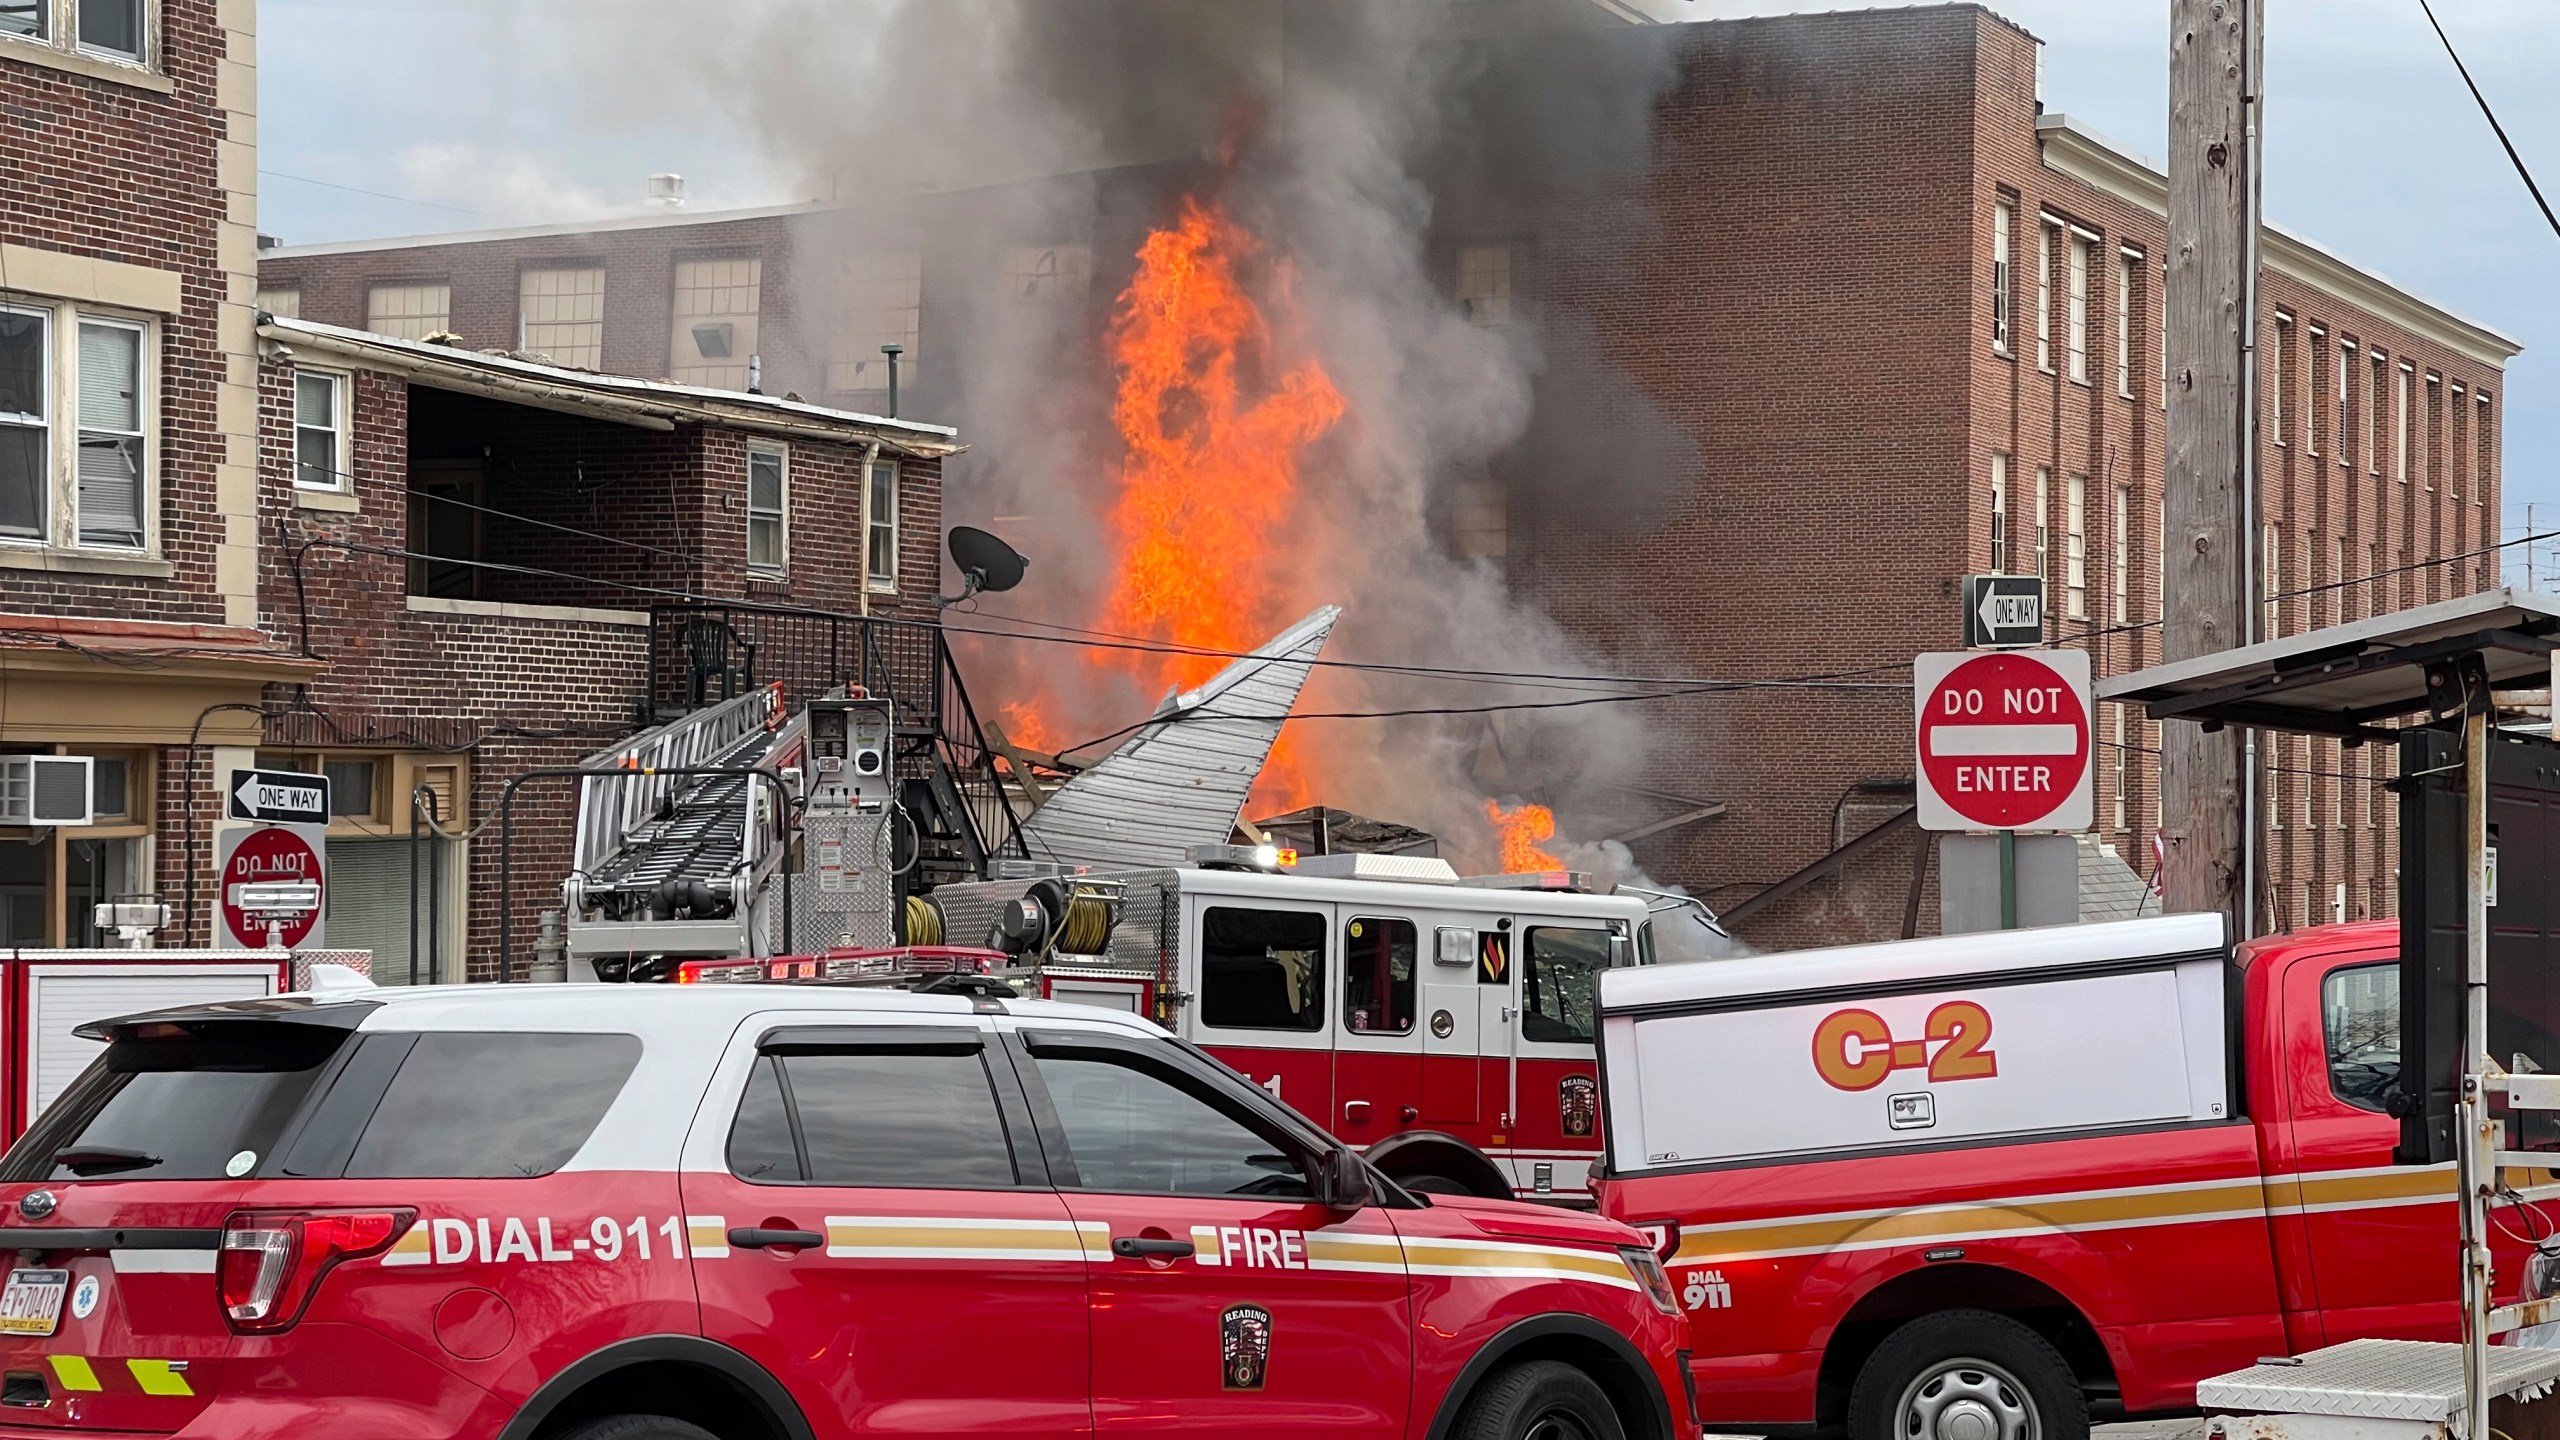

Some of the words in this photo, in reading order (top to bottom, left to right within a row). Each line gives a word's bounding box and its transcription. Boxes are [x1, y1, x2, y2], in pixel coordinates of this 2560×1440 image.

[1995, 598, 2013, 624] ONE
[2017, 598, 2036, 624] WAY
[1944, 689, 1984, 715] DO
[2003, 687, 2062, 714] NOT
[1956, 766, 2051, 792] ENTER
[258, 787, 285, 807] ONE
[290, 789, 318, 809] WAY
[237, 855, 261, 875] DO
[272, 852, 308, 871] NOT
[1812, 1001, 1998, 1091] C-2
[1561, 1078, 1595, 1089] READING
[433, 1216, 684, 1265] DIAL-911
[1220, 1227, 1305, 1269] FIRE
[1687, 1270, 1724, 1285] DIAL
[1683, 1283, 1732, 1310] 911
[1225, 1309, 1267, 1322] READING
